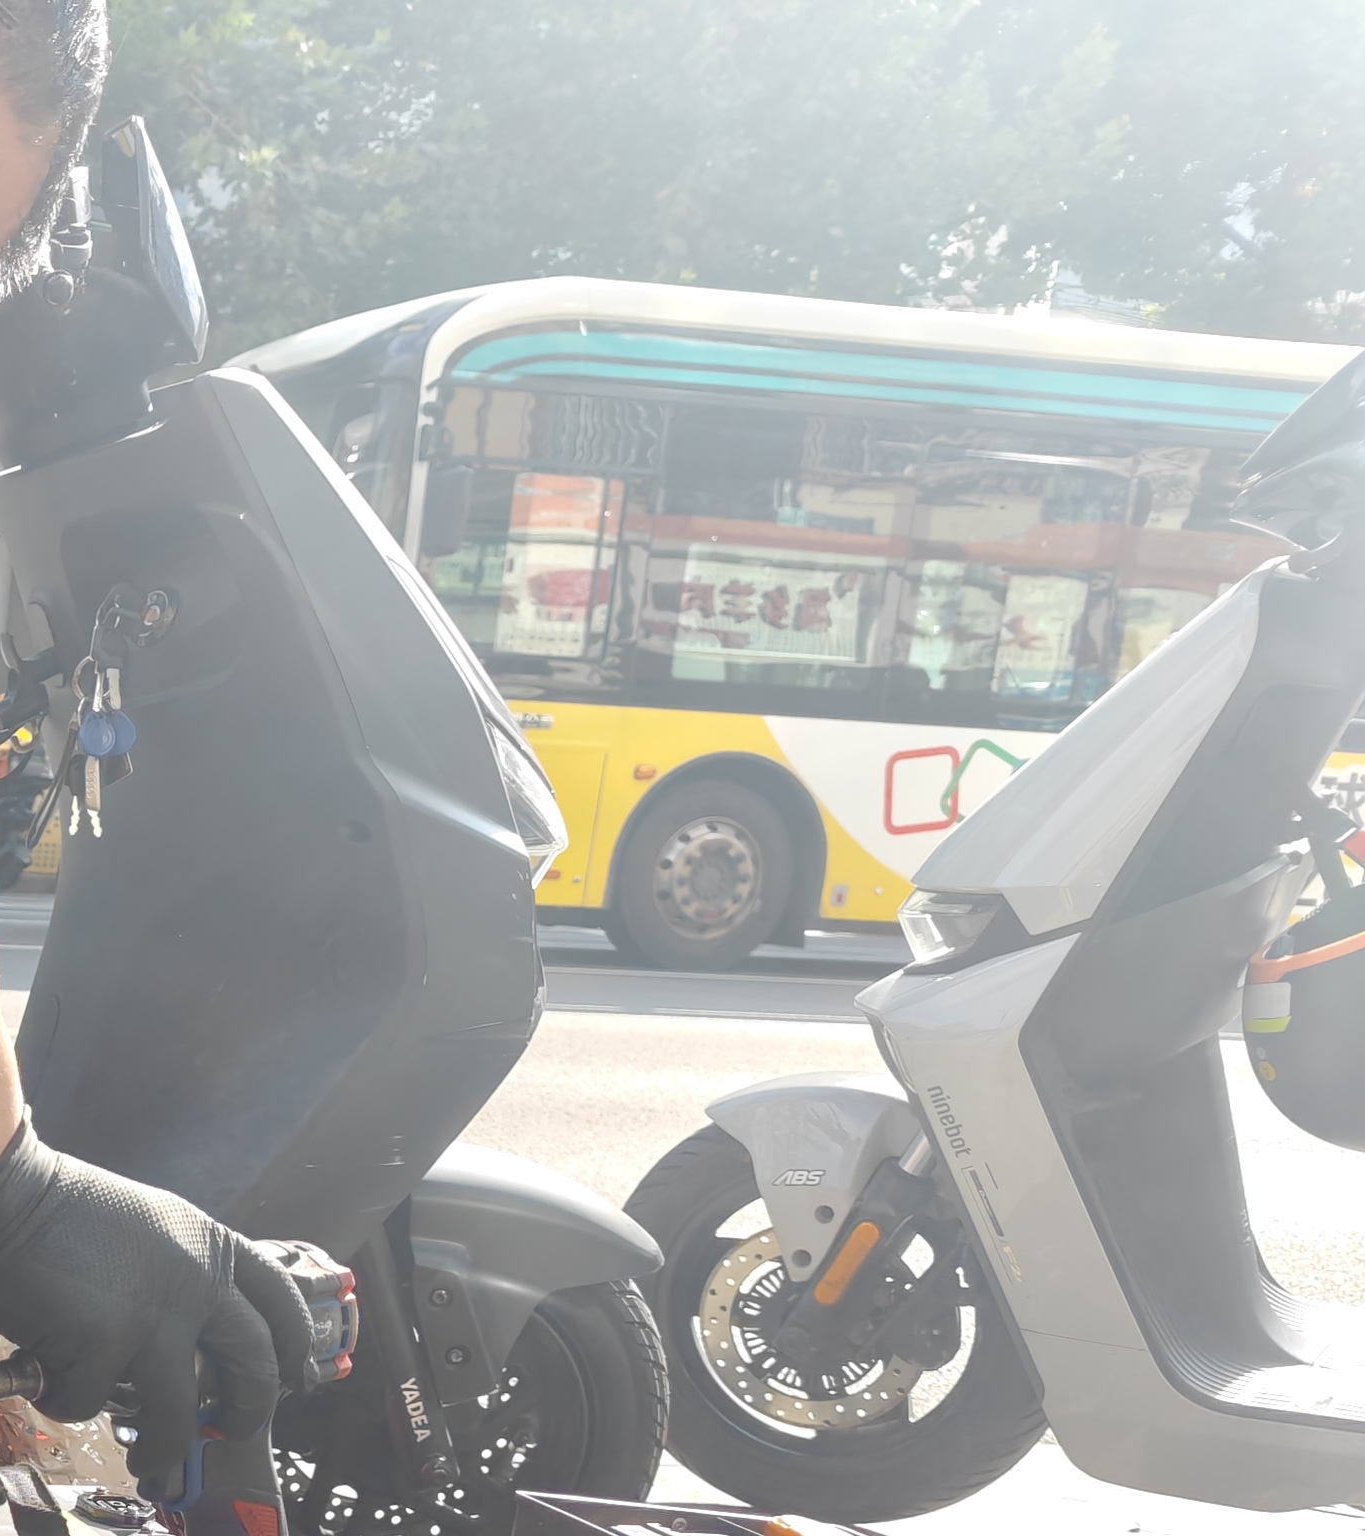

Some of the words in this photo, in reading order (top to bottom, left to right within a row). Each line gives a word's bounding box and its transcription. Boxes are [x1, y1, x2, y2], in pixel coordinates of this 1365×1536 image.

[927, 1085, 971, 1158] ninebot
[771, 1168, 827, 1187] ABS
[400, 1377, 431, 1442] YADEA
